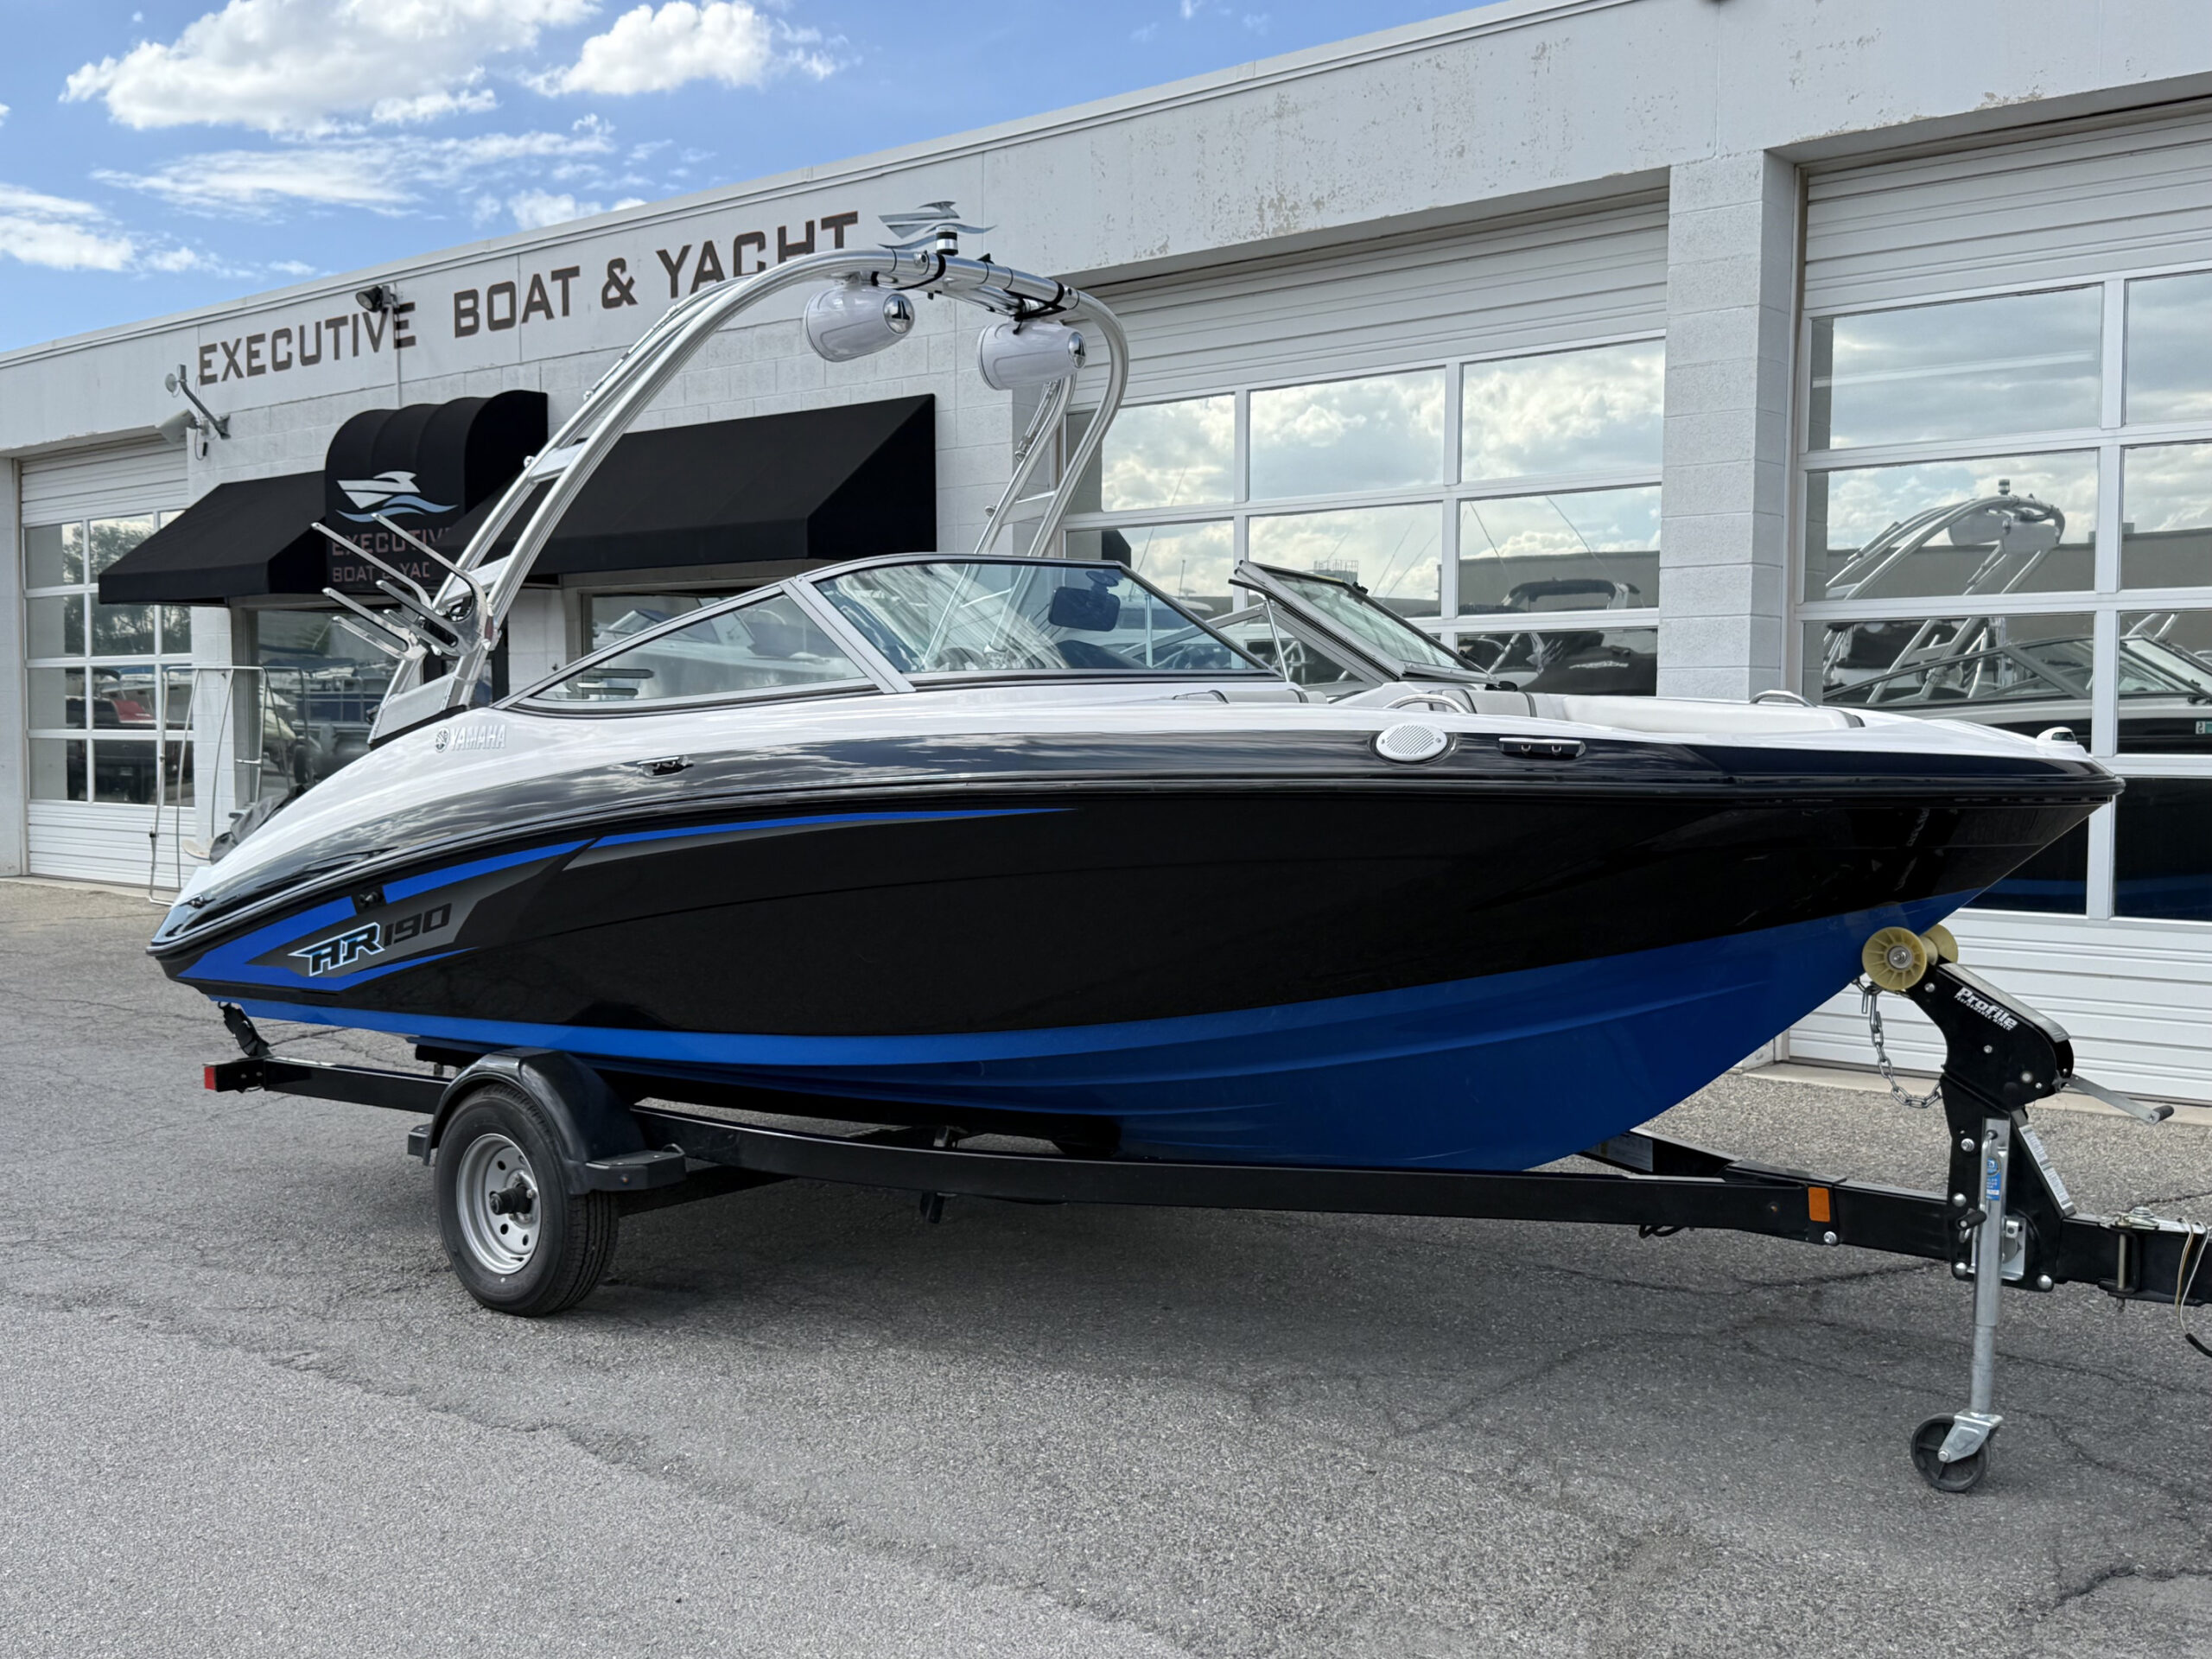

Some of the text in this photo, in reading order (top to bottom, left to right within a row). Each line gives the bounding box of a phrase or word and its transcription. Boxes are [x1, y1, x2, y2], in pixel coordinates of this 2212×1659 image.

[199, 211, 858, 385] EXECUTIVE BOAT & YACHT
[332, 527, 450, 556] EECUTIV
[333, 565, 375, 582] BOAT
[399, 561, 431, 578] YAC
[450, 725, 505, 751] YAMAHA
[1955, 987, 2018, 1029] Profile
